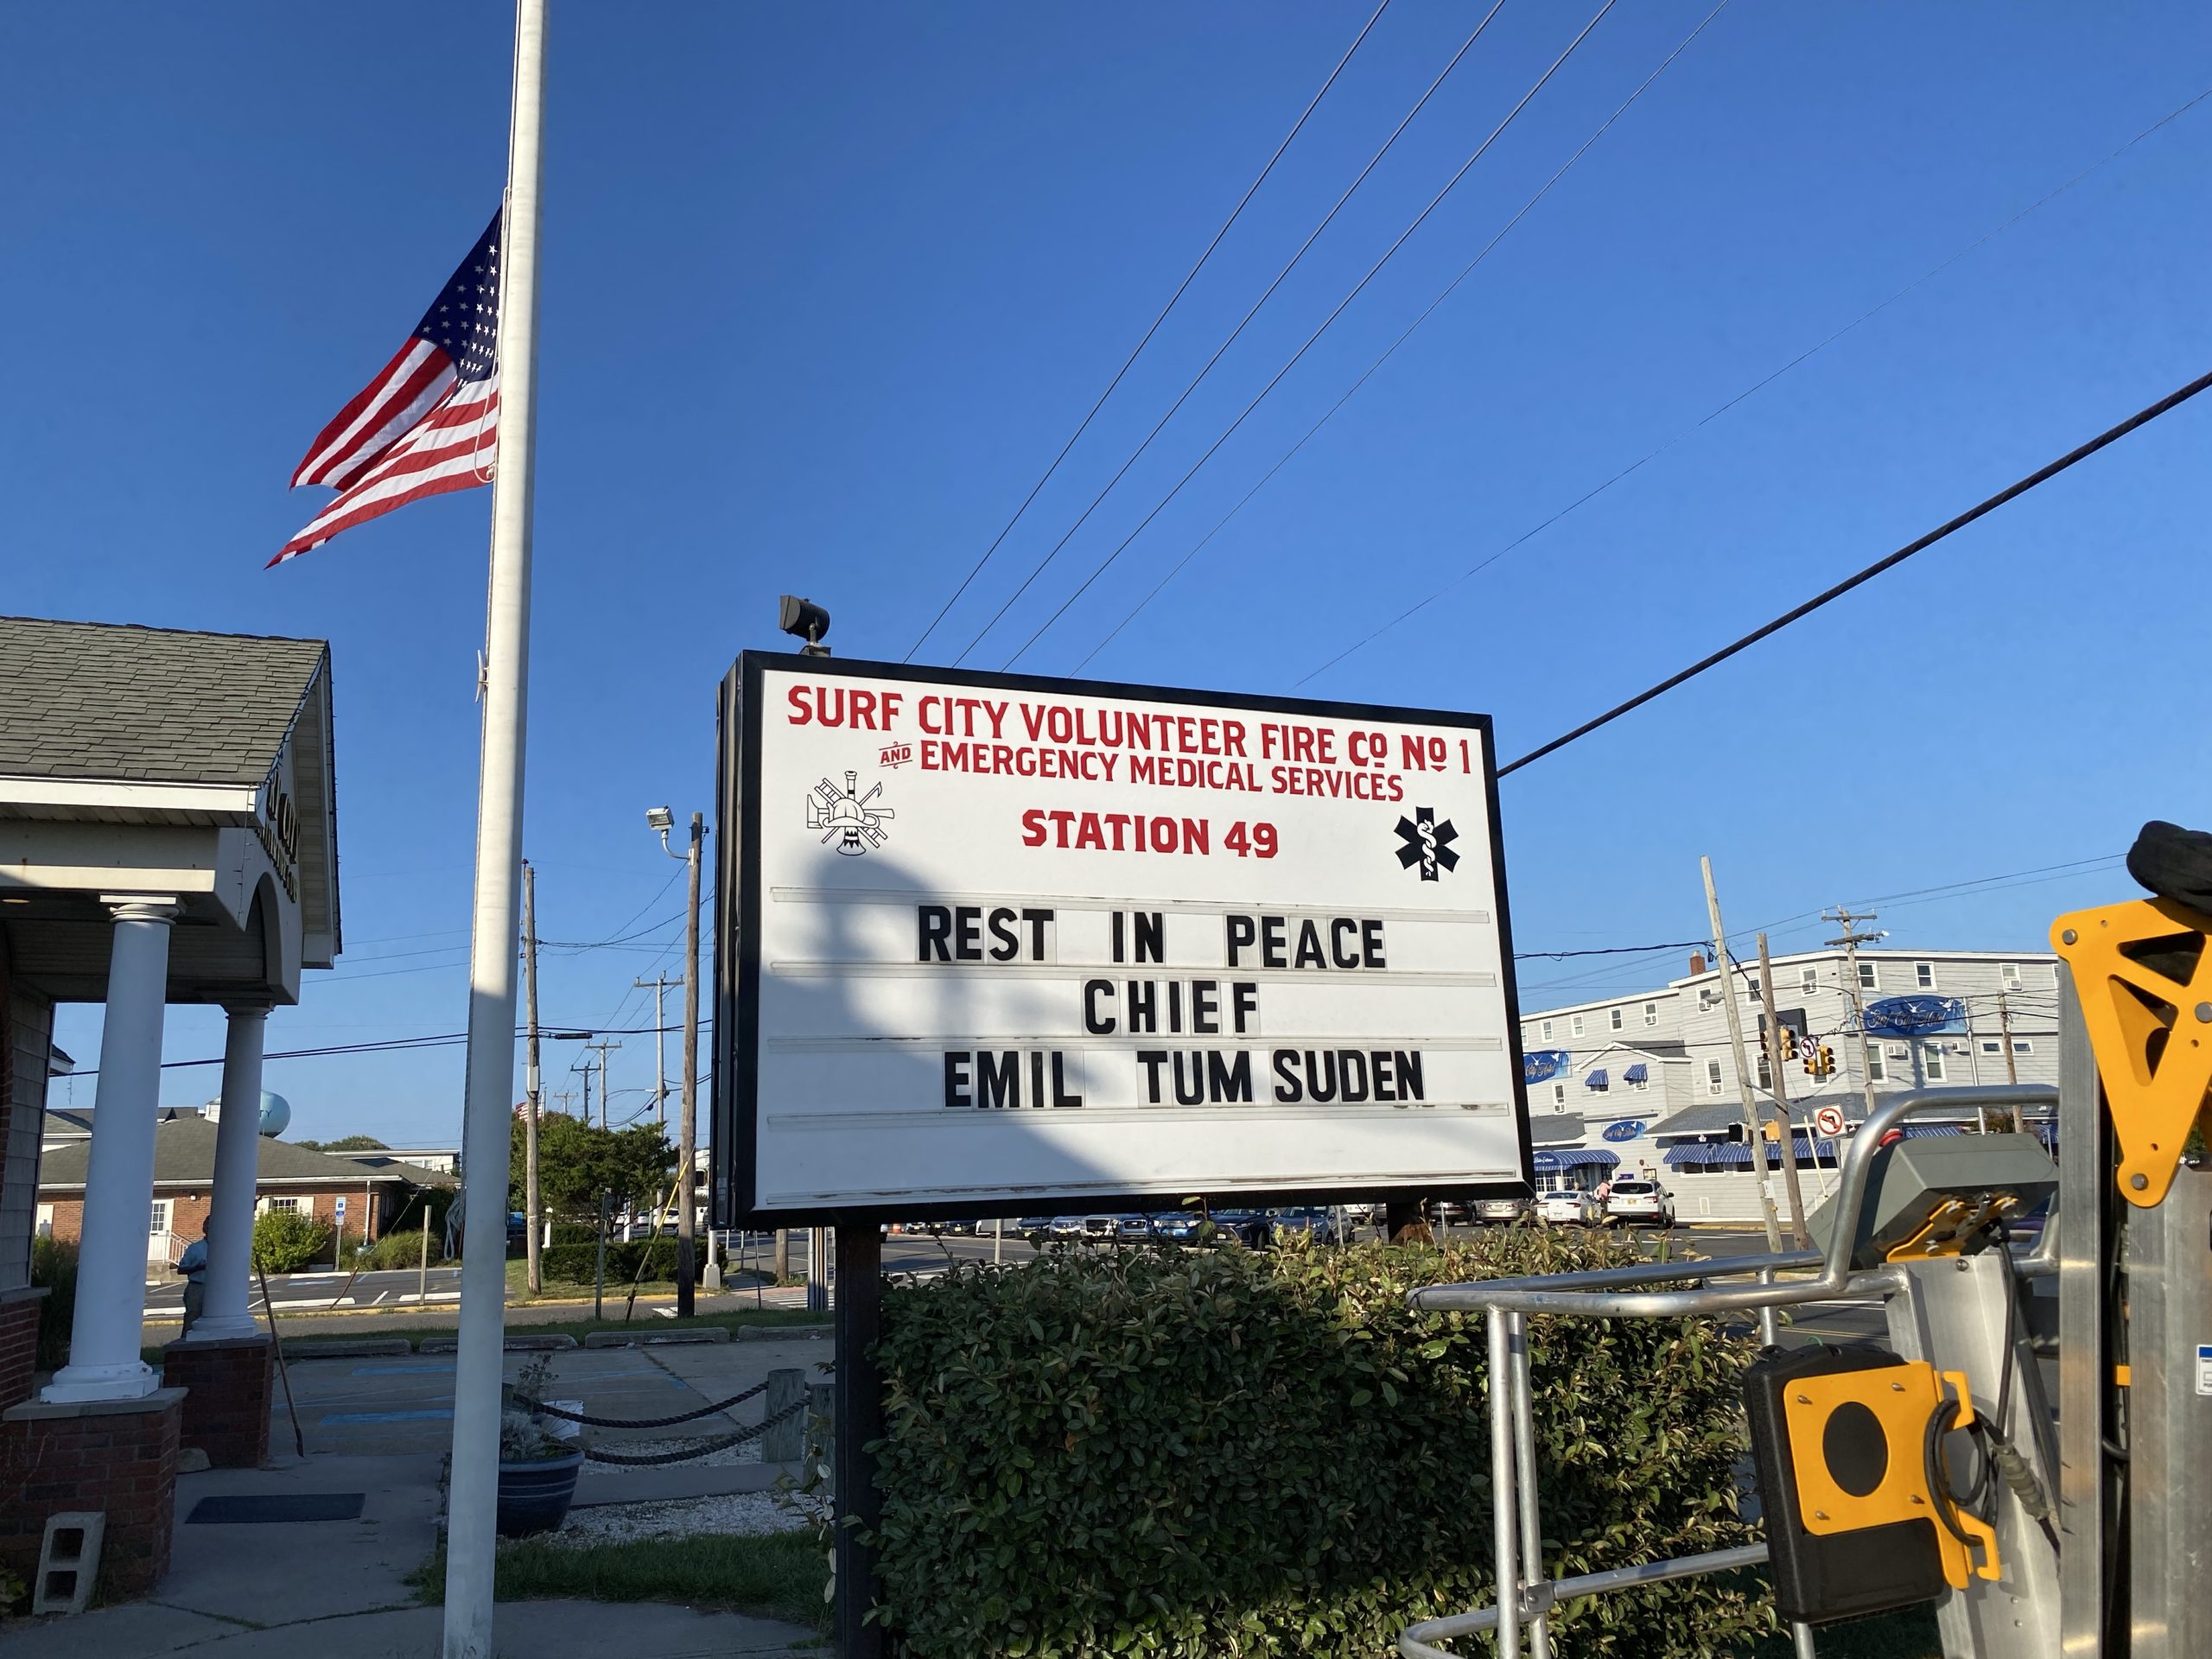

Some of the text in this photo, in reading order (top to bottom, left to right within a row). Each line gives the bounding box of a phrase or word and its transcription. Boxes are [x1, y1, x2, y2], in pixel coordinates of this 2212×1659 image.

[788, 686, 904, 731] SURF
[918, 696, 1009, 739] CITY
[1020, 702, 1246, 758] VOLUNTEER
[1262, 723, 1337, 767] FIRE
[1459, 740, 1471, 774] 1
[880, 740, 1404, 802] AND EMERGENCY MEDICAL SERVICES
[1022, 810, 1279, 859] STATION 49
[918, 906, 1386, 969] REST IN PEACE
[1084, 979, 1256, 1035] CHIEF
[944, 1049, 1425, 1108] EMIL TUM SUDEN
